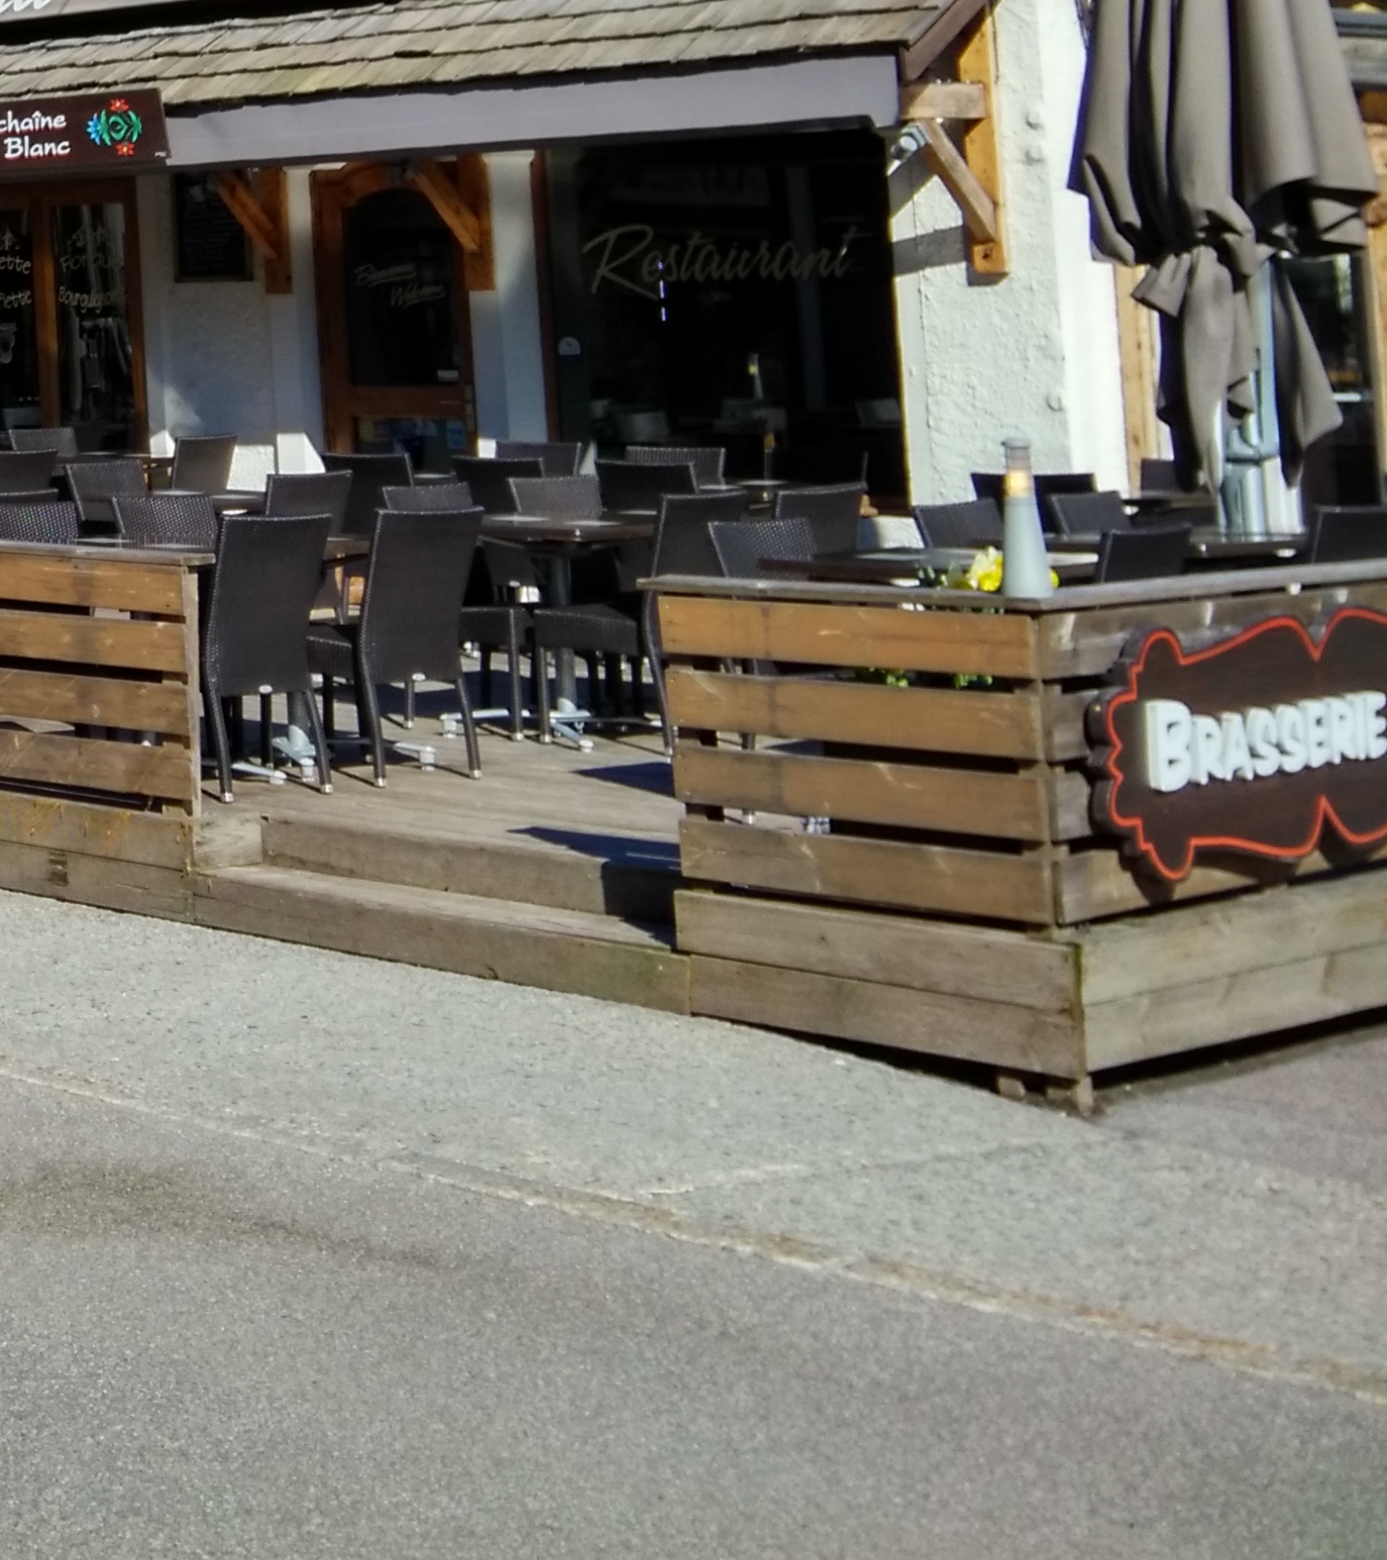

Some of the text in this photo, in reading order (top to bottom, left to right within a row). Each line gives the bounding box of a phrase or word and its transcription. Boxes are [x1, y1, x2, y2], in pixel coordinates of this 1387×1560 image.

[3, 135, 71, 159] Blanc
[581, 223, 874, 301] Restaurant
[1144, 690, 1387, 793] BRASSERIE
